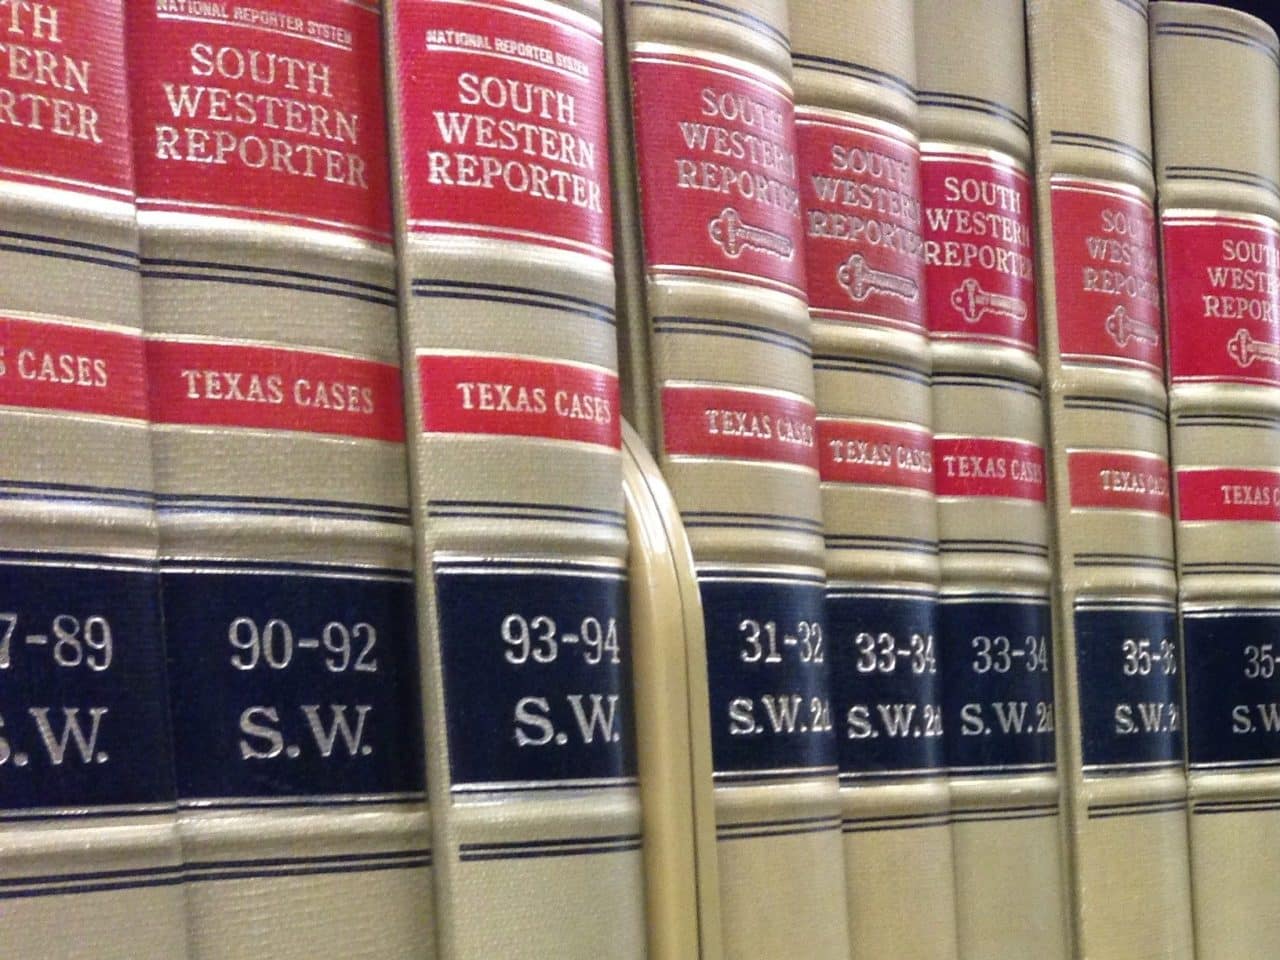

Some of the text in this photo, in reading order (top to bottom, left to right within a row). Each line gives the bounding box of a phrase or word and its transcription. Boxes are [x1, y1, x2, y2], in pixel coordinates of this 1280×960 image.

[233, 6, 304, 31] REPORTER
[307, 20, 353, 44] SYSTEM
[425, 29, 492, 50] NATIONAL
[494, 38, 554, 64] REPORTER
[191, 42, 334, 97] SOUTH
[163, 82, 359, 145] WESTERN
[457, 72, 577, 126] SOUTH
[154, 124, 369, 190] REPORTER
[433, 111, 595, 170] WESTERN
[427, 150, 603, 214] REPORTER
[943, 176, 1021, 215] SOUTH
[181, 368, 375, 415] TEXAS CASES
[457, 382, 611, 425] TEXAS CASES
[705, 408, 772, 439] TEXAS
[830, 438, 892, 467] TEXAS
[943, 455, 1005, 480] TEXAS
[1221, 485, 1270, 506] TEXAS
[228, 616, 378, 674] 90-92
[501, 613, 622, 666] 93-94
[738, 618, 824, 663] 31-32
[855, 632, 937, 674] 33-34
[971, 634, 1048, 675] 33-34
[238, 704, 373, 761] S.W.
[514, 694, 621, 747] S.W.
